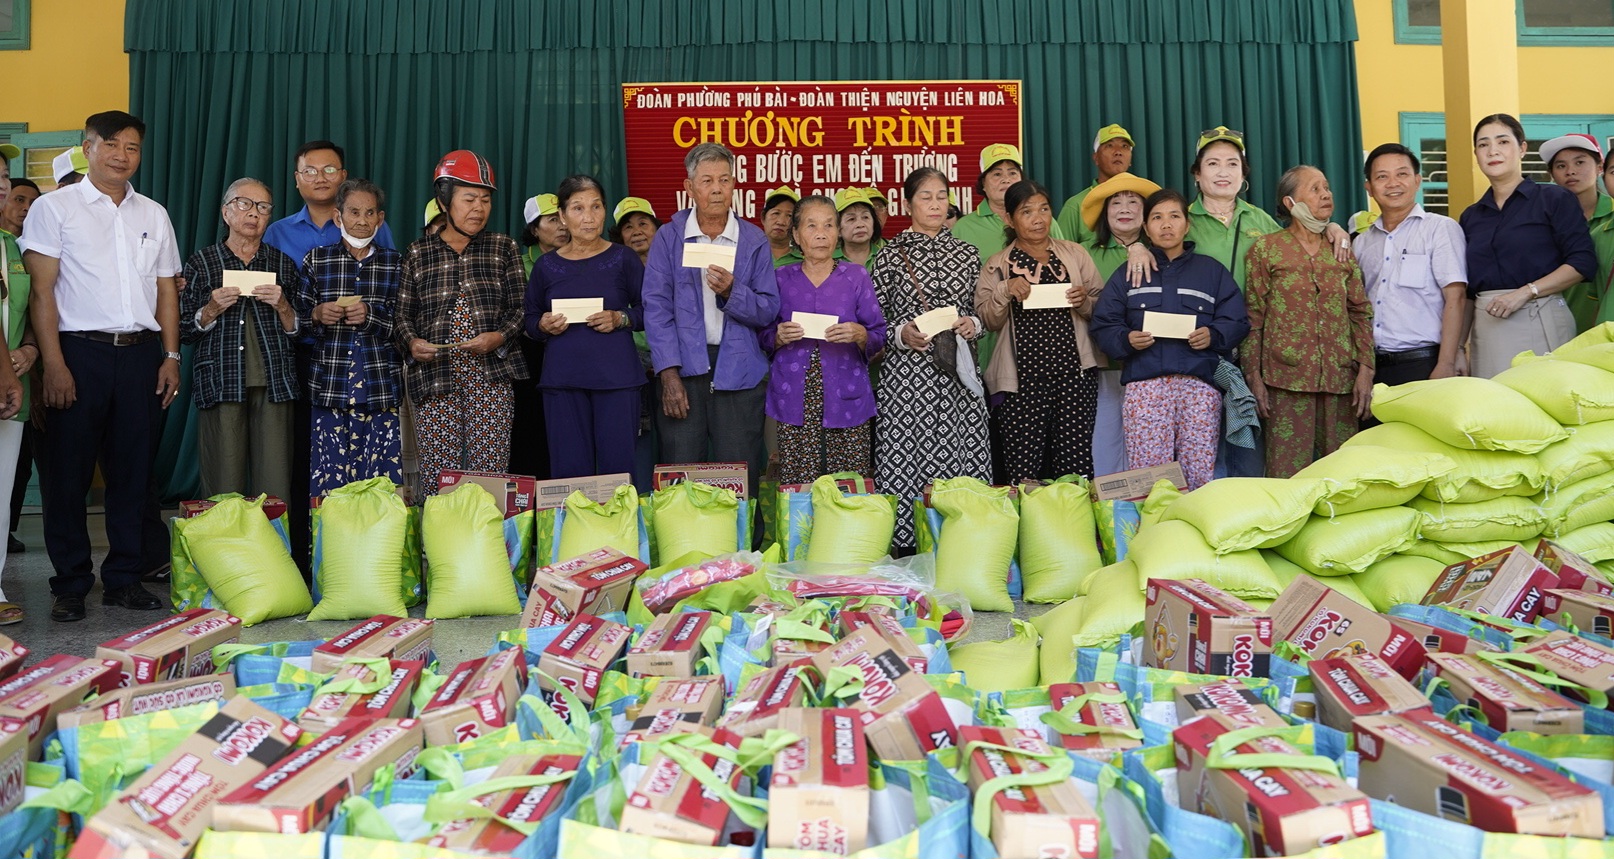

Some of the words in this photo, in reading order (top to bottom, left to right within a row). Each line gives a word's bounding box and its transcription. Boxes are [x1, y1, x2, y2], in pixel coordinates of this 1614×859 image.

[637, 87, 671, 108] ĐOÀN
[677, 85, 730, 107] PHƯỜNG
[737, 86, 762, 107] PHÚ
[765, 86, 787, 107] BÀI
[799, 86, 834, 107] ĐOÀN
[840, 88, 879, 111] THIỆN
[886, 87, 938, 111] NGUYỆN
[944, 87, 973, 106] LIÊN
[979, 91, 1005, 106] HOA
[673, 110, 825, 148] CHƯƠNG
[848, 108, 965, 147] TRÌNH
[755, 149, 803, 183] BƯỚC
[812, 154, 842, 183] EM
[848, 146, 883, 183] ĐẾN
[441, 475, 455, 484] MỚI
[533, 602, 543, 617] CAY
[1521, 587, 1541, 611] CAY
[1260, 621, 1270, 638] MỚI
[1302, 610, 1341, 654] KOK
[1232, 634, 1253, 677] KOK
[1382, 634, 1407, 657] MỚI
[137, 661, 150, 680] MỚI
[584, 670, 598, 689] MỚI
[1328, 667, 1348, 682] TÔM
[1199, 683, 1257, 715] KOKOMI
[1338, 679, 1361, 696] CHUA
[1349, 692, 1371, 705] CAY
[480, 699, 498, 721] MỚI
[211, 715, 276, 766] KOKOMI
[929, 730, 956, 750] AY
[1453, 733, 1499, 755] CHUA
[1239, 768, 1265, 781] UA
[1254, 776, 1291, 798] CAY
[1351, 804, 1371, 833] MỚI
[818, 820, 829, 851] HUA
[1078, 824, 1097, 853] MỚI
